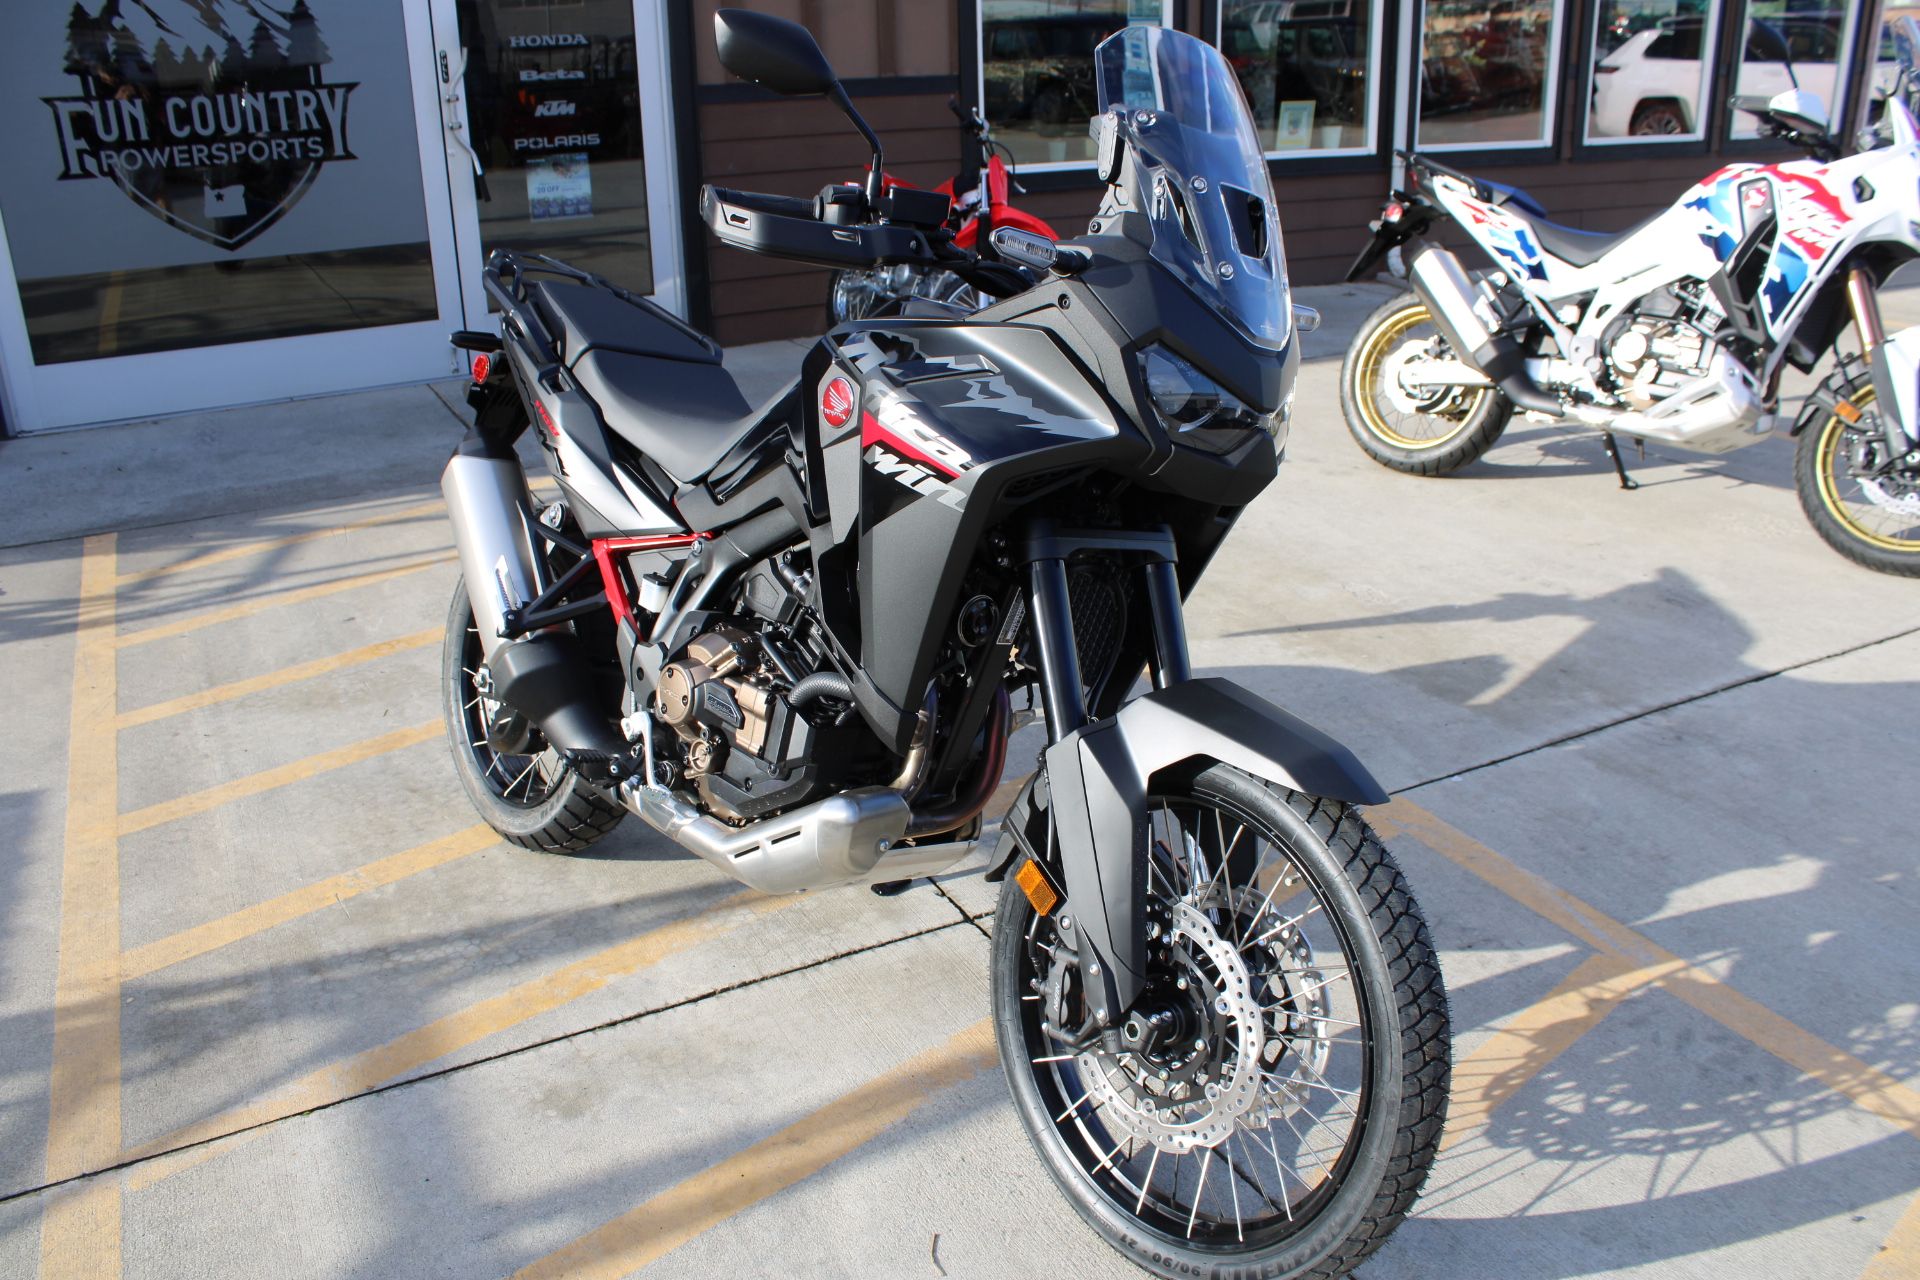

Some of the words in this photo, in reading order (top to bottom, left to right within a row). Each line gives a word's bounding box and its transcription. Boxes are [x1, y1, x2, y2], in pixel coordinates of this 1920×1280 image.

[508, 33, 590, 48] HONDA
[519, 69, 586, 81] Beta
[534, 100, 576, 117] KTM
[53, 97, 149, 175] FUN
[166, 87, 347, 157] COUNTRY
[514, 133, 601, 150] POLARIS
[101, 137, 324, 172] POWERSPORTS
